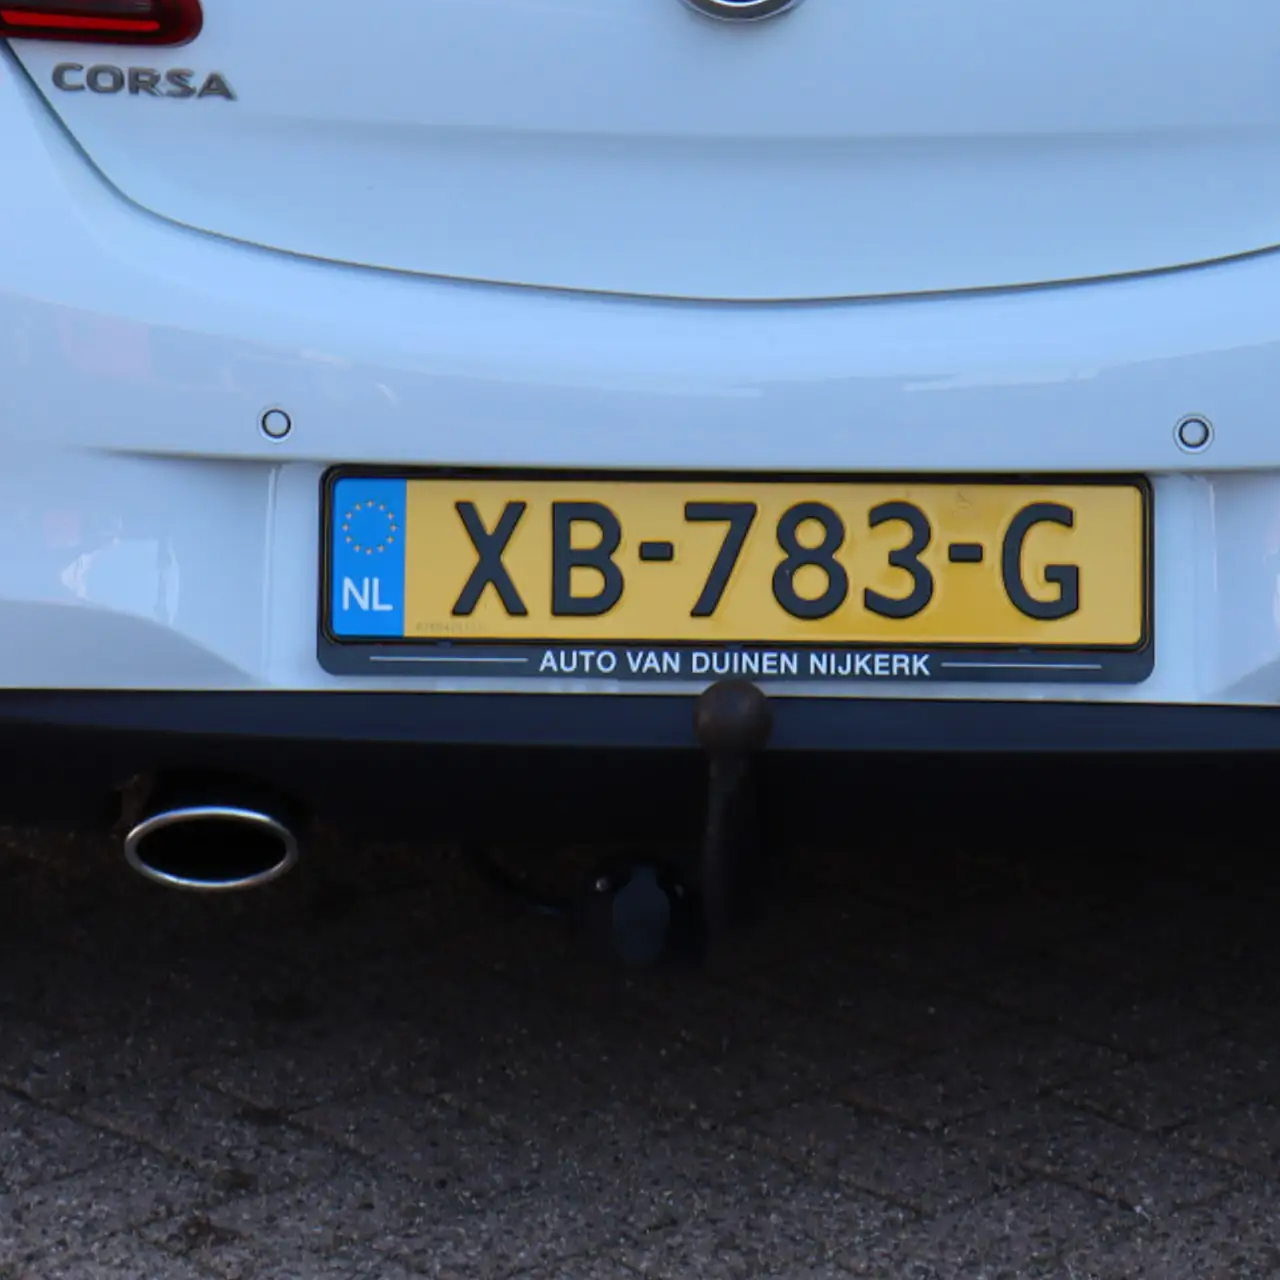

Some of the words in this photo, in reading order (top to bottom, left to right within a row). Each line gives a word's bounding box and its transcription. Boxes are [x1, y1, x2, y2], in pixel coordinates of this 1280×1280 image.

[51, 62, 238, 101] CORSA
[451, 500, 1081, 621] XB-783-G
[343, 576, 393, 611] NL
[539, 650, 617, 673] AUTO
[626, 651, 680, 673] VAN
[692, 652, 797, 675] DUINEN
[810, 653, 931, 676] NIJKERK
